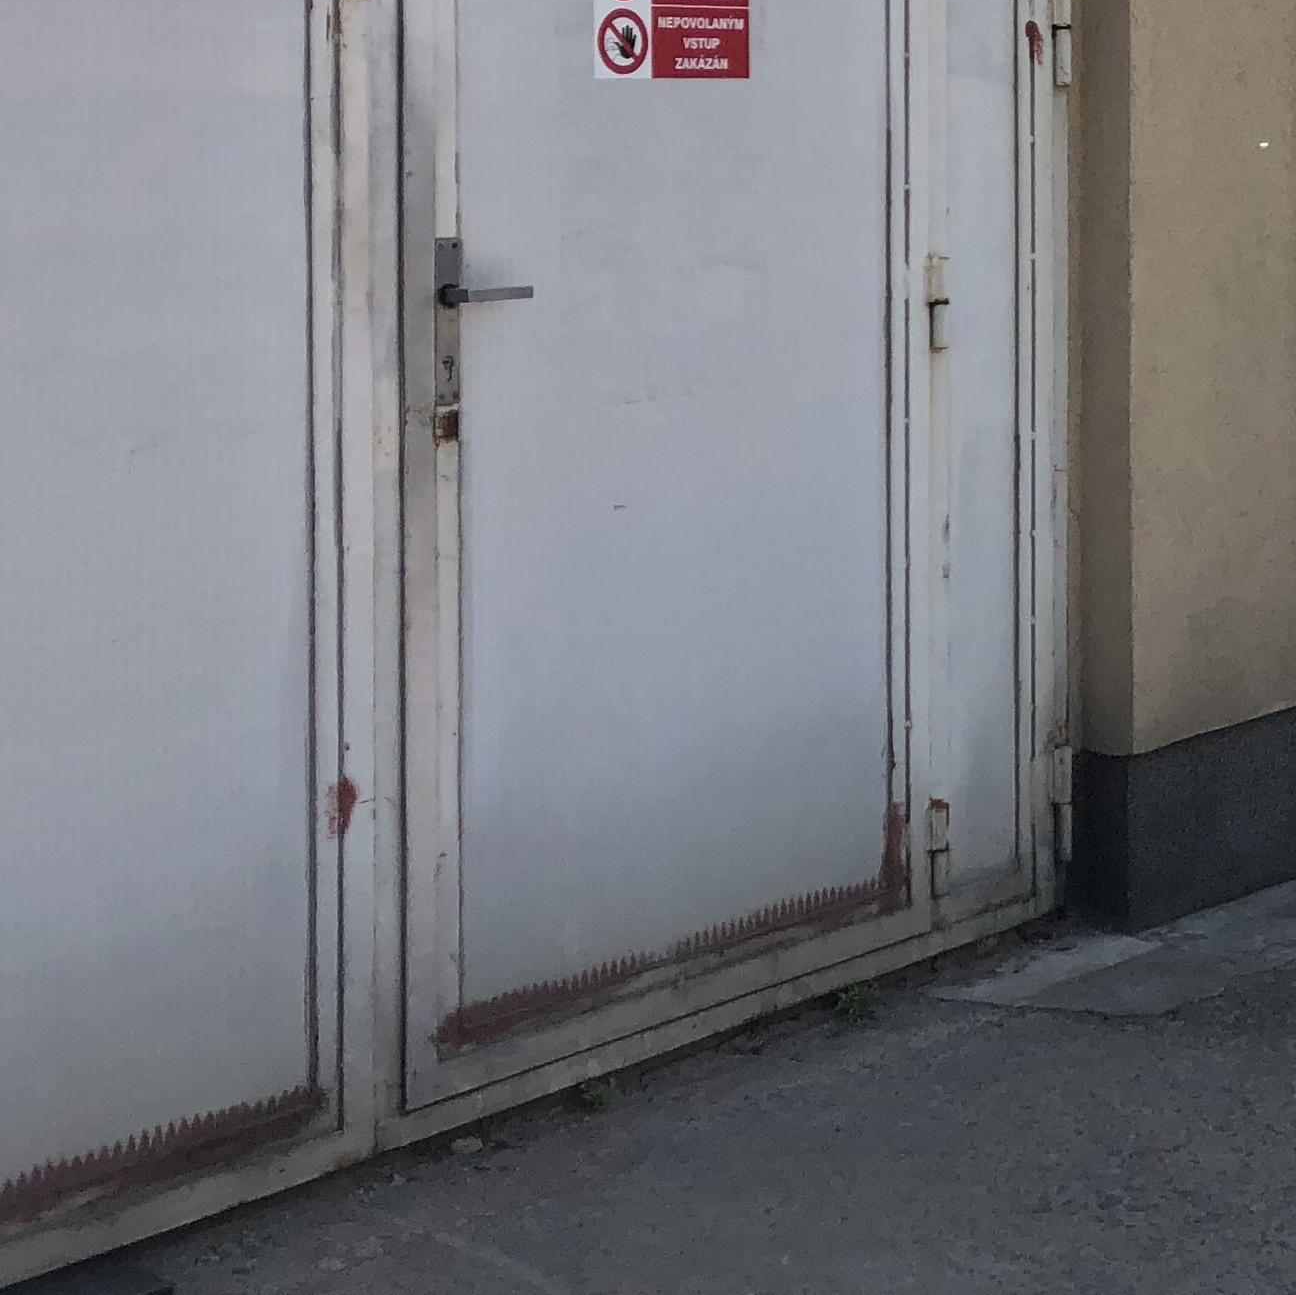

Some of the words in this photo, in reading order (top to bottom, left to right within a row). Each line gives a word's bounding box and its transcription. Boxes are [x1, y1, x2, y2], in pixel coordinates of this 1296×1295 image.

[657, 14, 745, 31] NEPOVOLANÝM
[683, 37, 721, 50] VSTUP
[674, 54, 729, 70] ZAKÁZÁN
